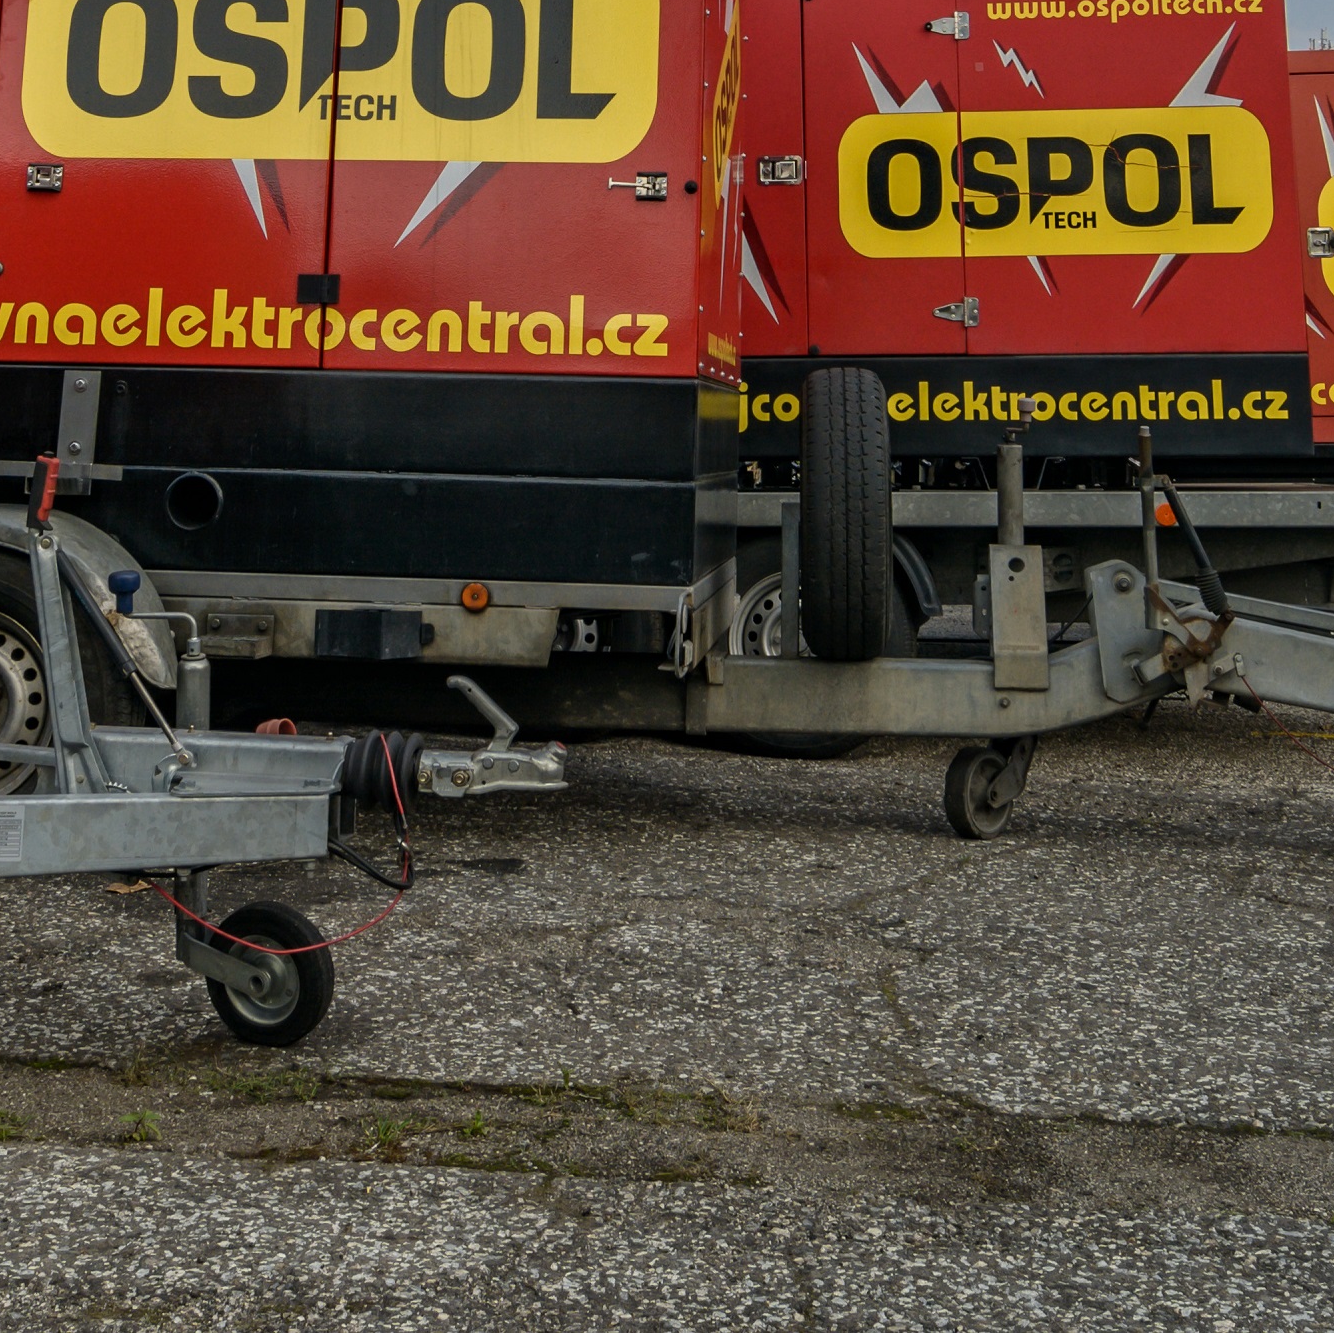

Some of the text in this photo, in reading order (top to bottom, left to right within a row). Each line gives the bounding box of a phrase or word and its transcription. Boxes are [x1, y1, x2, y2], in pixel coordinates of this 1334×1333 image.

[318, 94, 398, 121] TECH
[866, 133, 1246, 231] OSPOL
[1042, 211, 1098, 230] TECH
